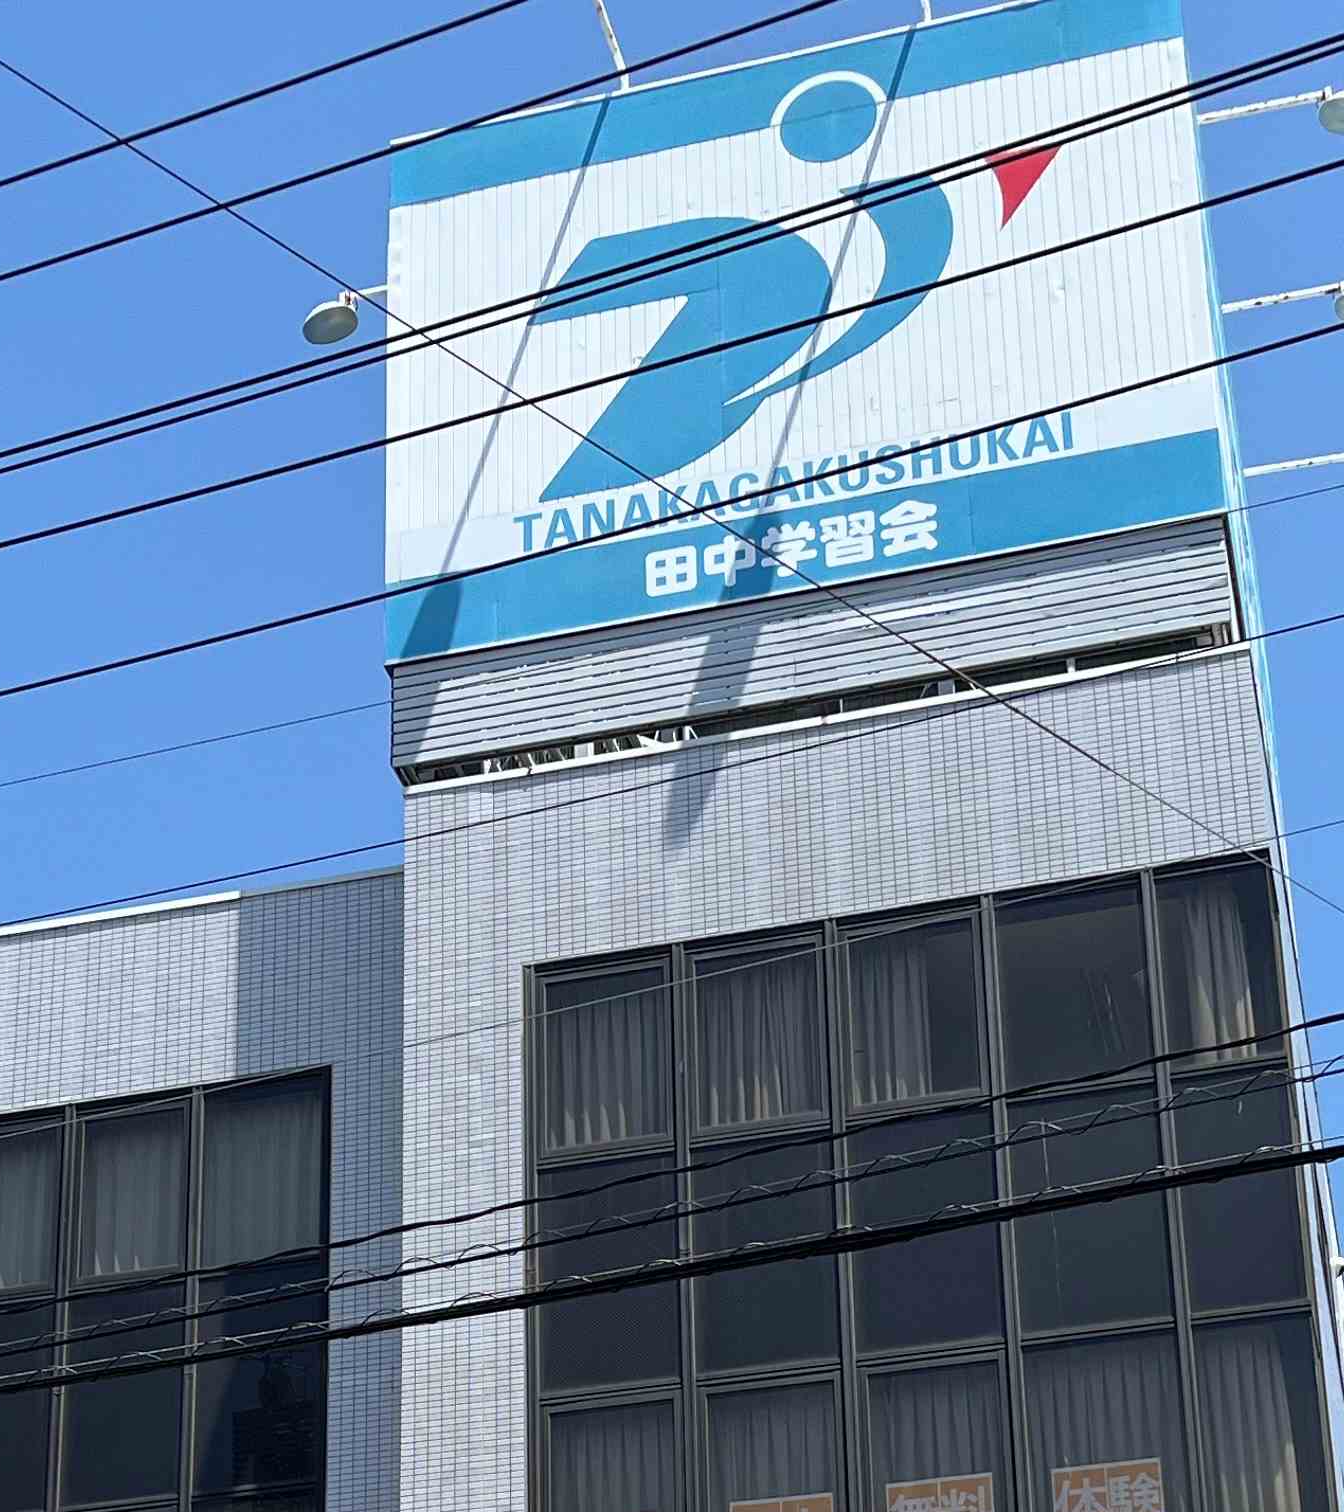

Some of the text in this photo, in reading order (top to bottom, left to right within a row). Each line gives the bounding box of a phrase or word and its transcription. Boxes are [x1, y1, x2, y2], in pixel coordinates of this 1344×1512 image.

[513, 411, 1076, 552] TANAKAGAKUSHUKAI
[645, 498, 939, 598] 田中学習会
